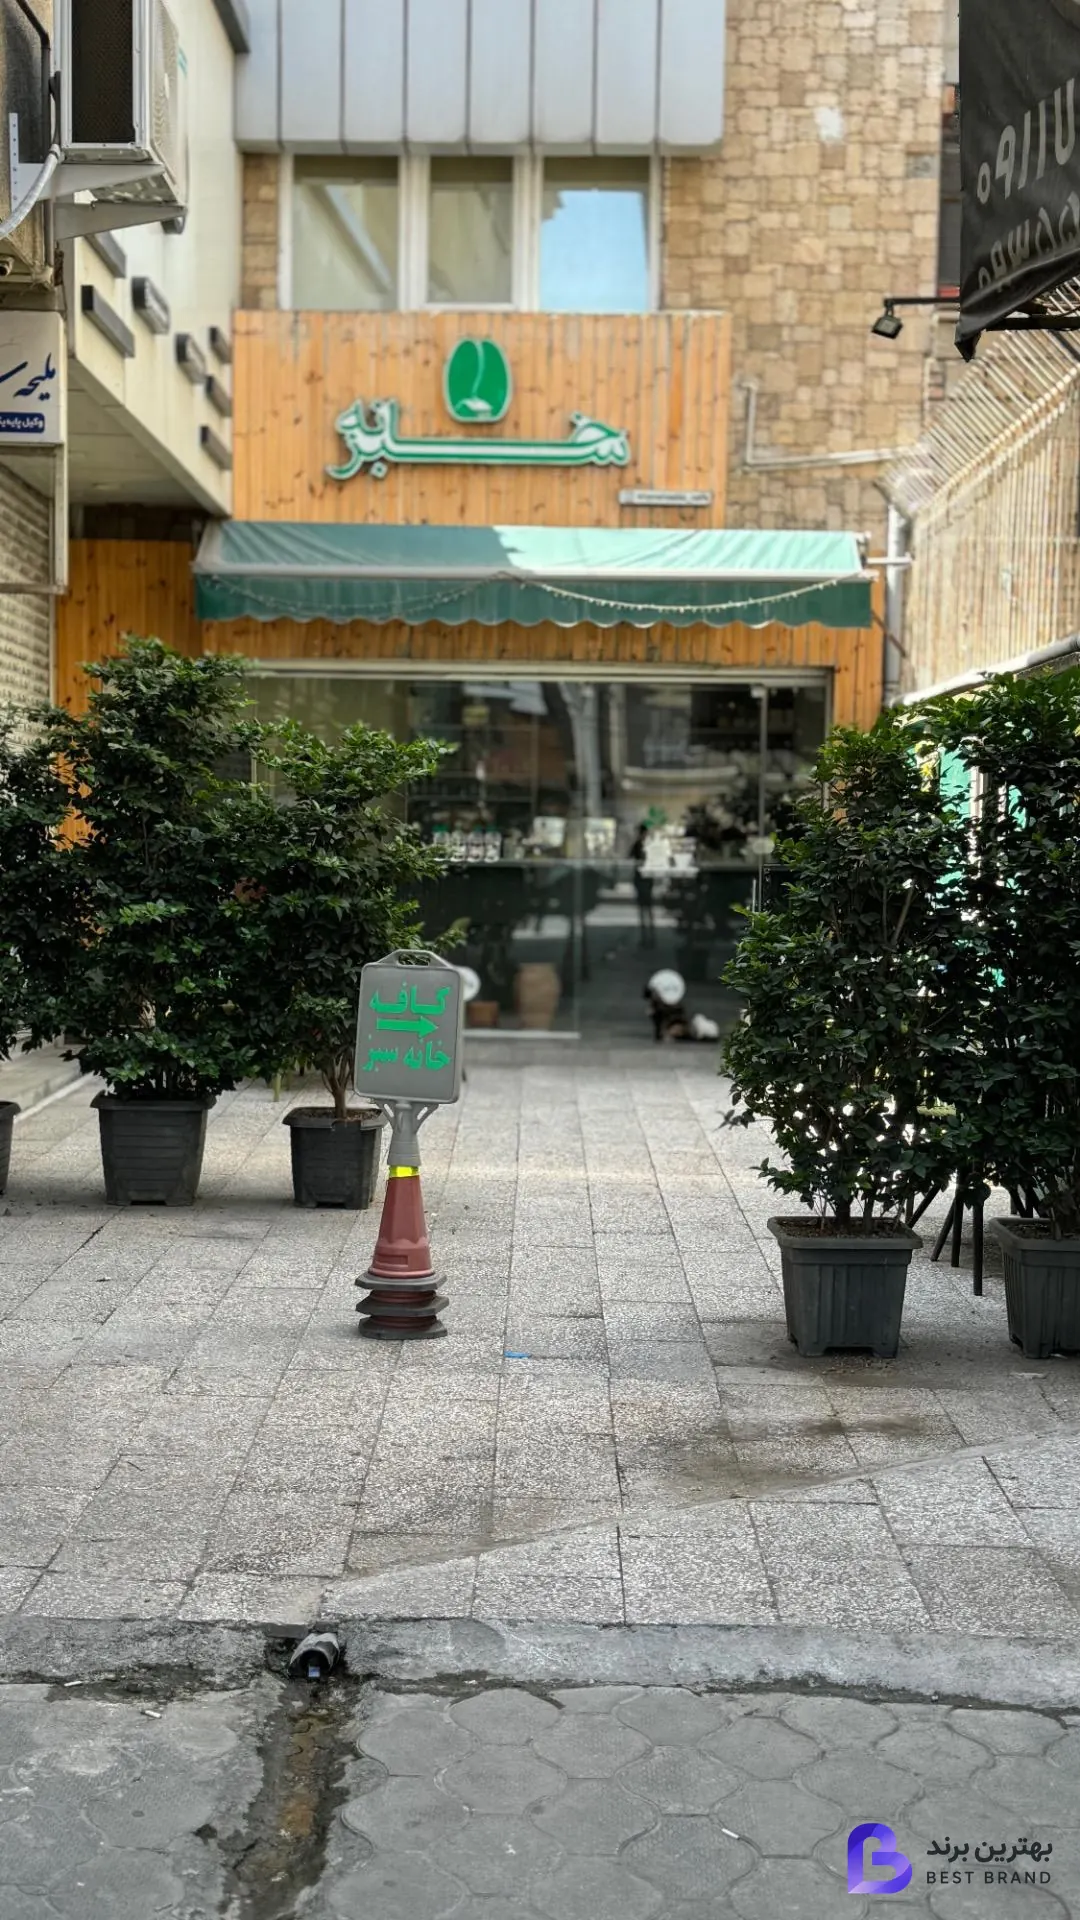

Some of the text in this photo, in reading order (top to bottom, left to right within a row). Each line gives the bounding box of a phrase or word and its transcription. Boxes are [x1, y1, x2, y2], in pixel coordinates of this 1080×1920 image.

[370, 981, 452, 1015] کافه
[362, 1034, 450, 1072] خانه سبز
